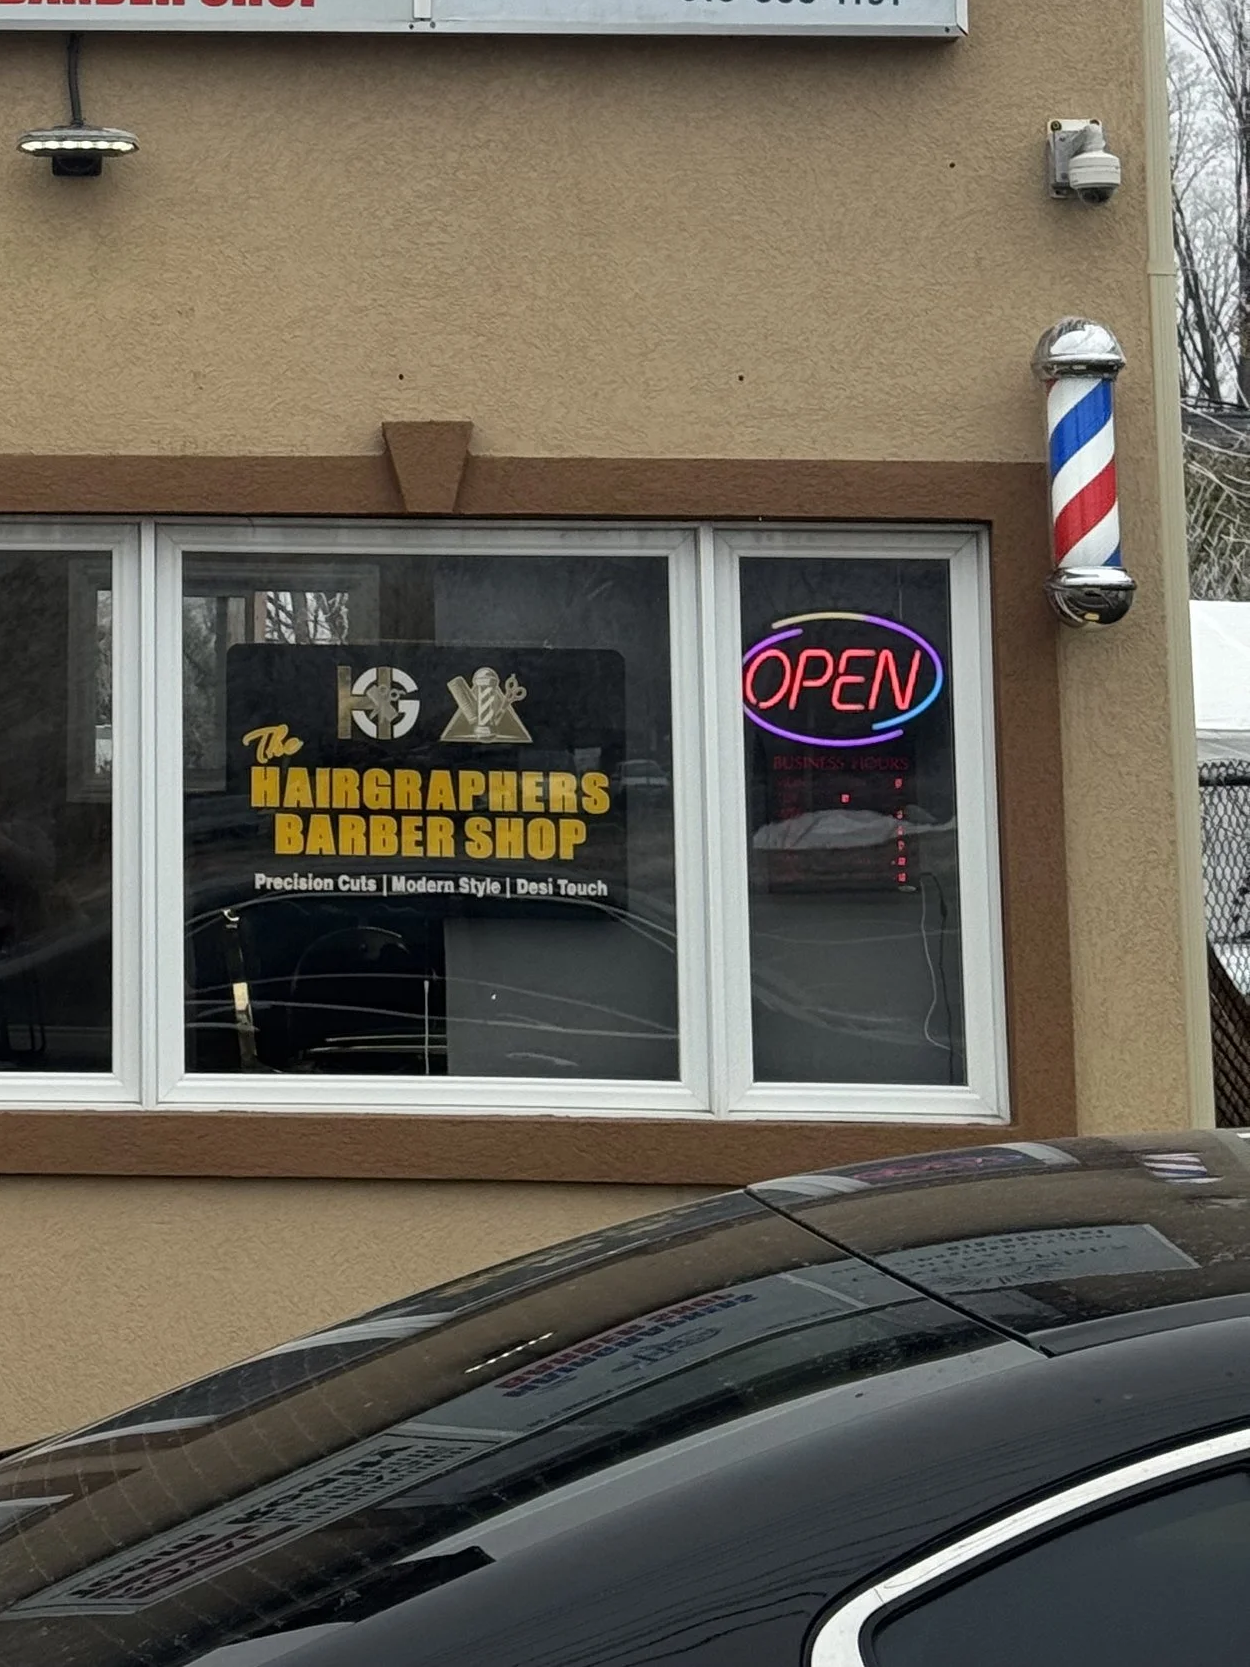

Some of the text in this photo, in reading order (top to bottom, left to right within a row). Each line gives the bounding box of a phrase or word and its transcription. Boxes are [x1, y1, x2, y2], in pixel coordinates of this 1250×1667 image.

[745, 648, 922, 711] OPEN
[242, 723, 304, 764] The
[250, 765, 611, 815] HAIRGRAPHERS
[274, 813, 587, 861] BARBER SHOP
[254, 873, 608, 898] Precision Cuts Modern Style Desi Touch
